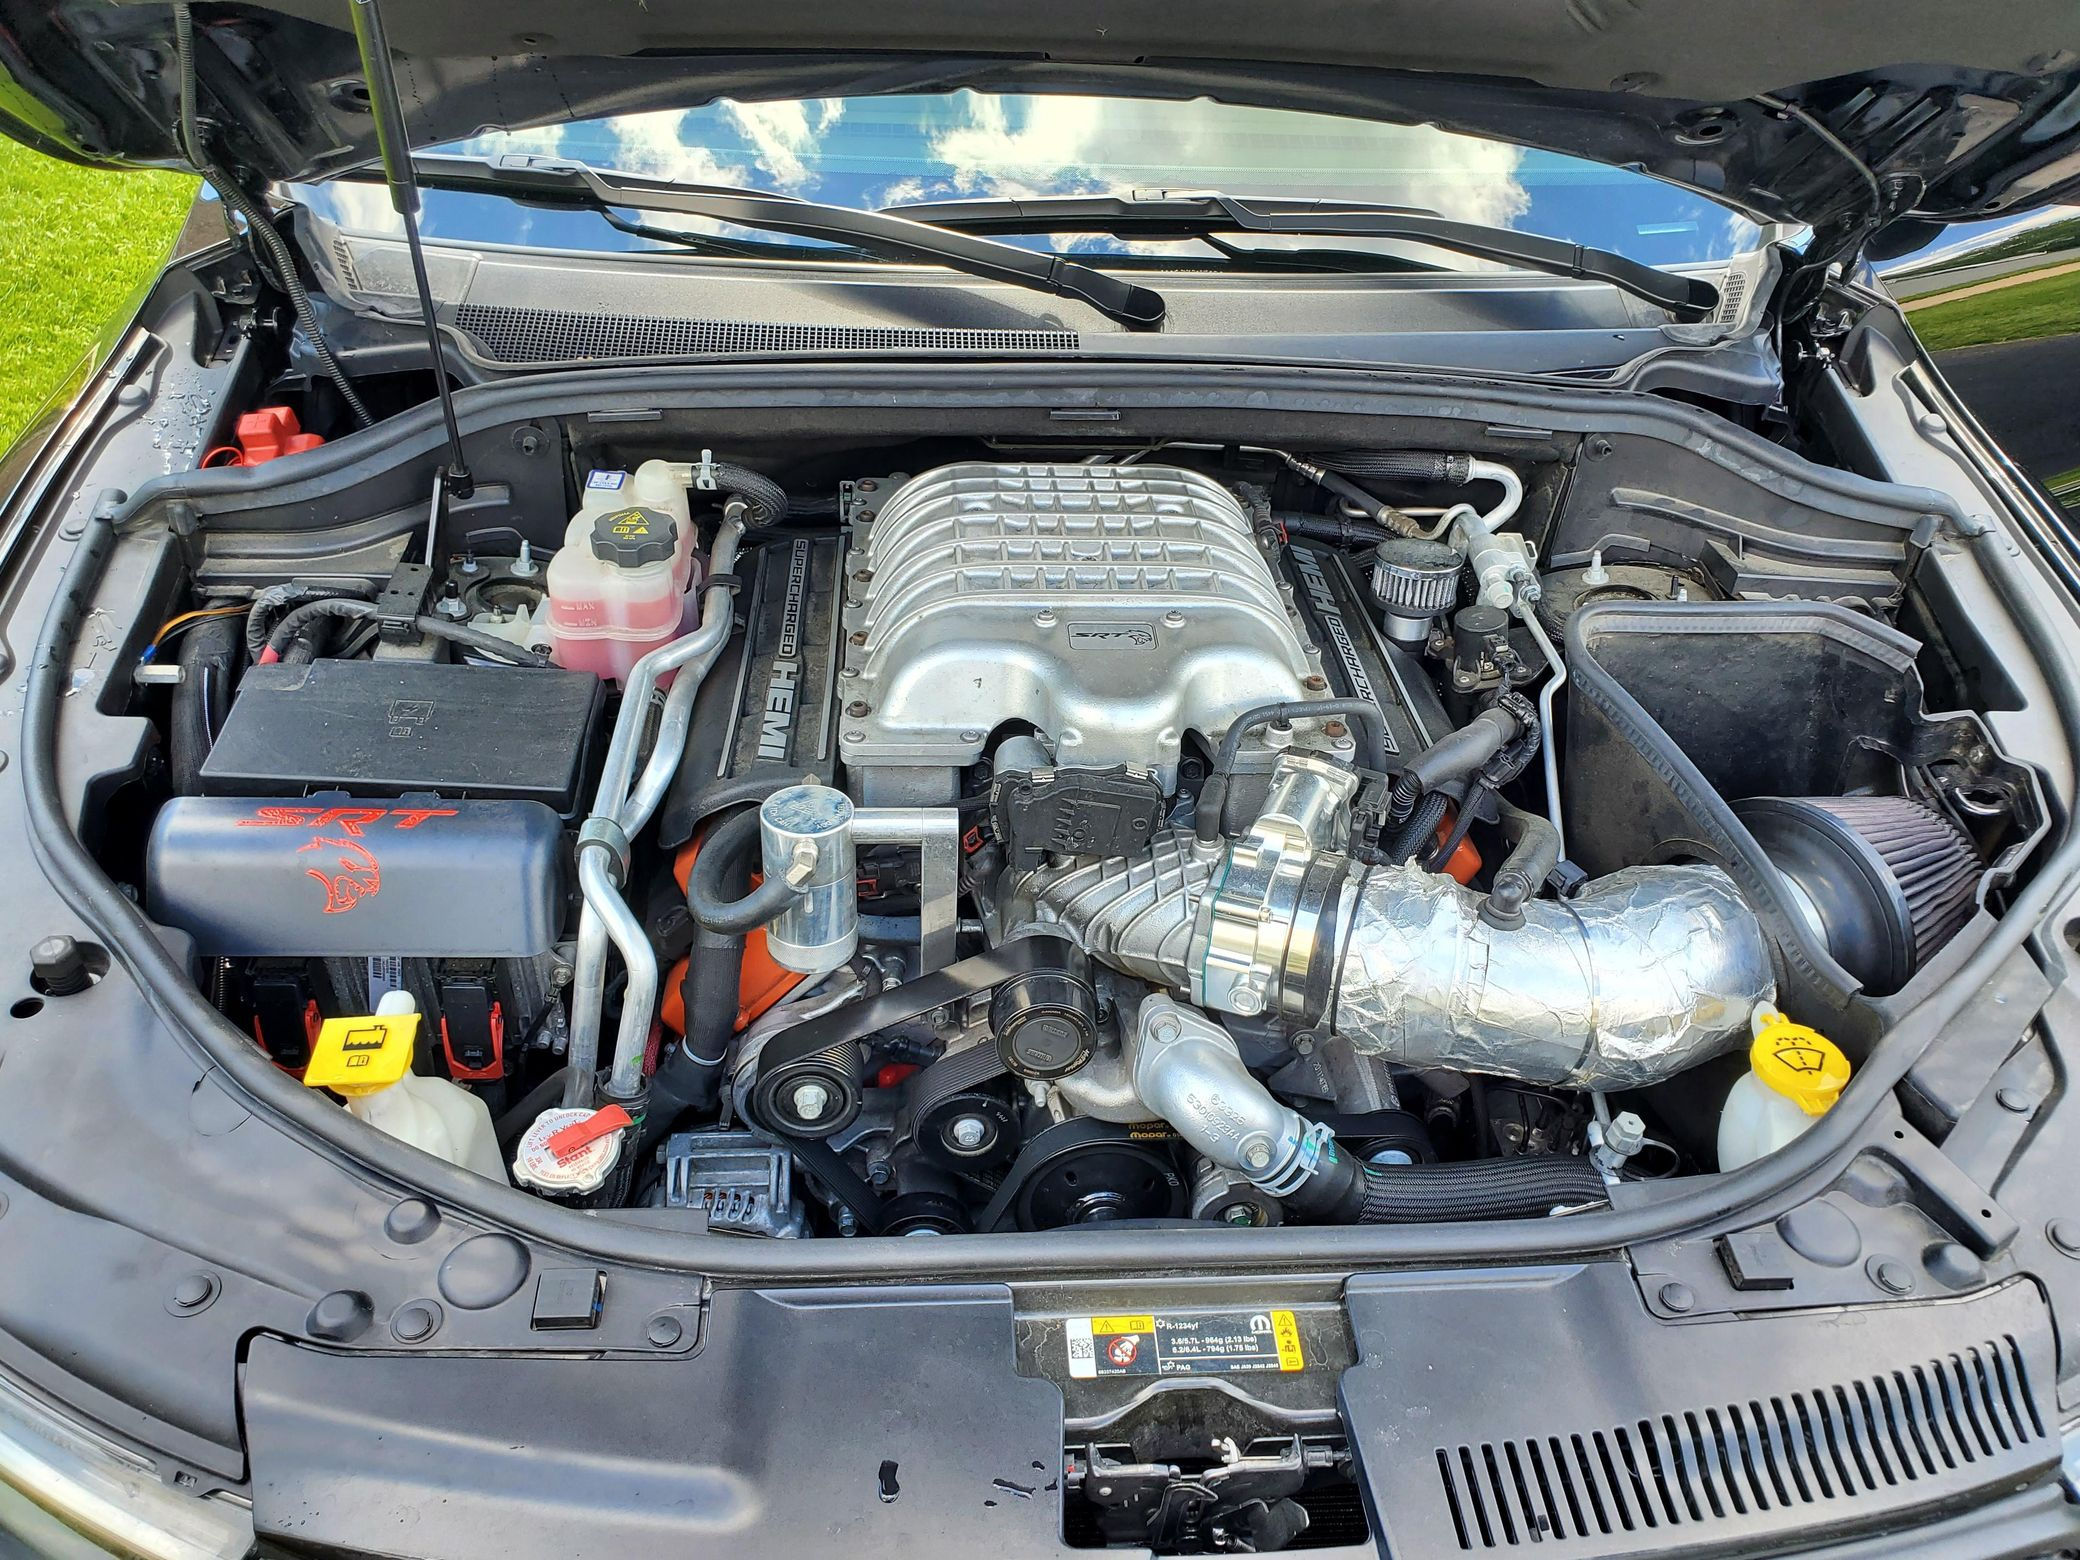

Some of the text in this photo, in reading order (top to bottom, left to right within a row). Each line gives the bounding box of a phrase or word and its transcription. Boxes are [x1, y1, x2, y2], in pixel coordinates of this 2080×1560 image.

[1071, 632, 1129, 640] SRT
[757, 540, 807, 759] SUPERCHARGED HEMI
[1290, 545, 1397, 751] SRCHARGED HEMI
[235, 806, 460, 837] SRT
[554, 1112, 577, 1121] UNLOCK
[557, 1146, 593, 1168] Stant
[1166, 1322, 1199, 1331] R-1234yf
